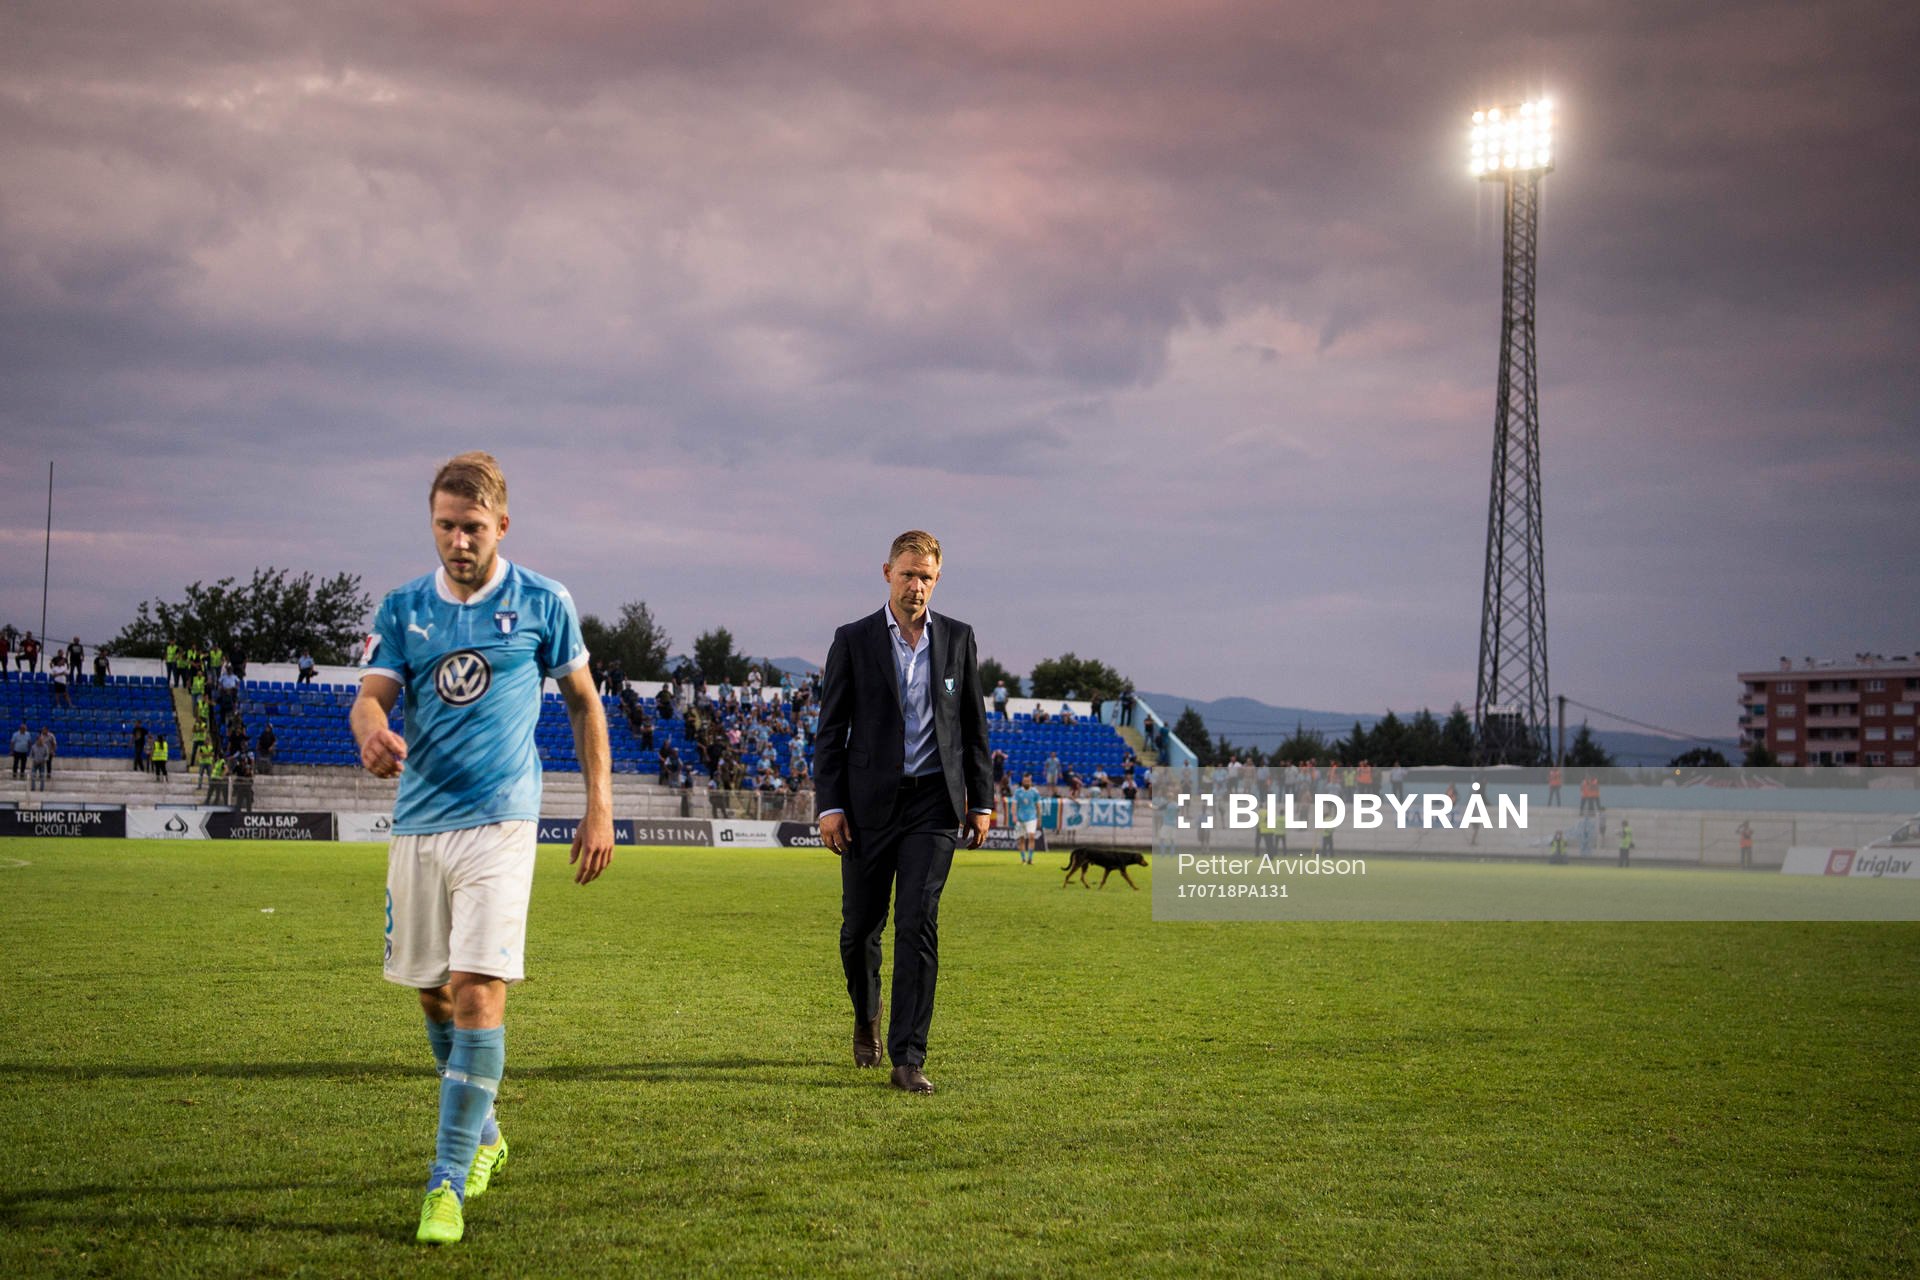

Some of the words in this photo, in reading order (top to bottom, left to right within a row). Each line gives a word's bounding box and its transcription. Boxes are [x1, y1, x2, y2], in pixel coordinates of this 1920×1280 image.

[16, 811, 65, 823] ТЕННИС
[67, 812, 102, 824] ПАРК
[243, 815, 274, 827] СКАЈ
[276, 816, 299, 828] БАР
[34, 823, 82, 836] СКОПЈЕ
[230, 827, 266, 839] ХОТЕЛ
[639, 829, 708, 841] SISTINA
[1856, 855, 1912, 878] triglav
